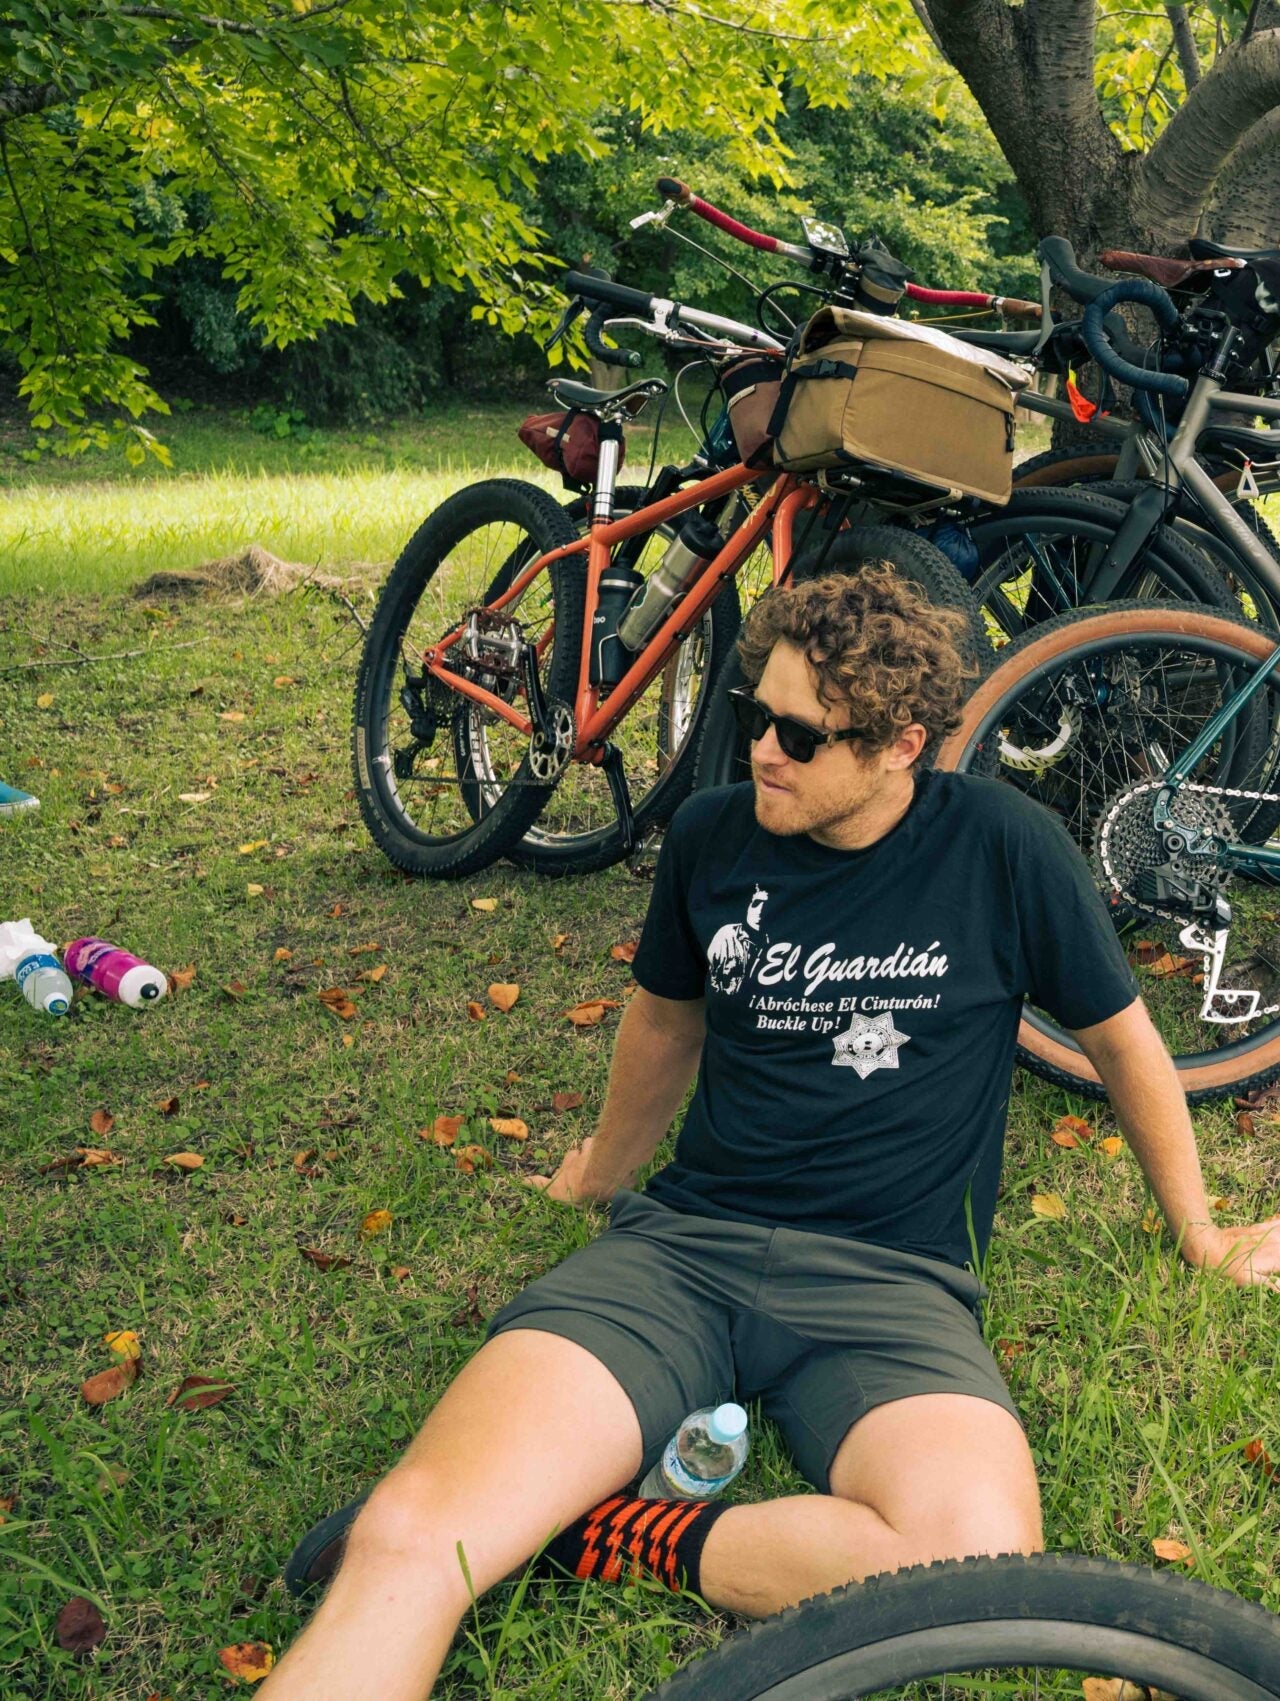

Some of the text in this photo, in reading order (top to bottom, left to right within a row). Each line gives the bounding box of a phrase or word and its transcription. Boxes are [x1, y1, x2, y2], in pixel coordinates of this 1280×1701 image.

[758, 940, 949, 996] El Guardián
[749, 994, 941, 1012] ¡Abróchese El Cinturón!
[756, 1015, 841, 1034] Buckle Up!
